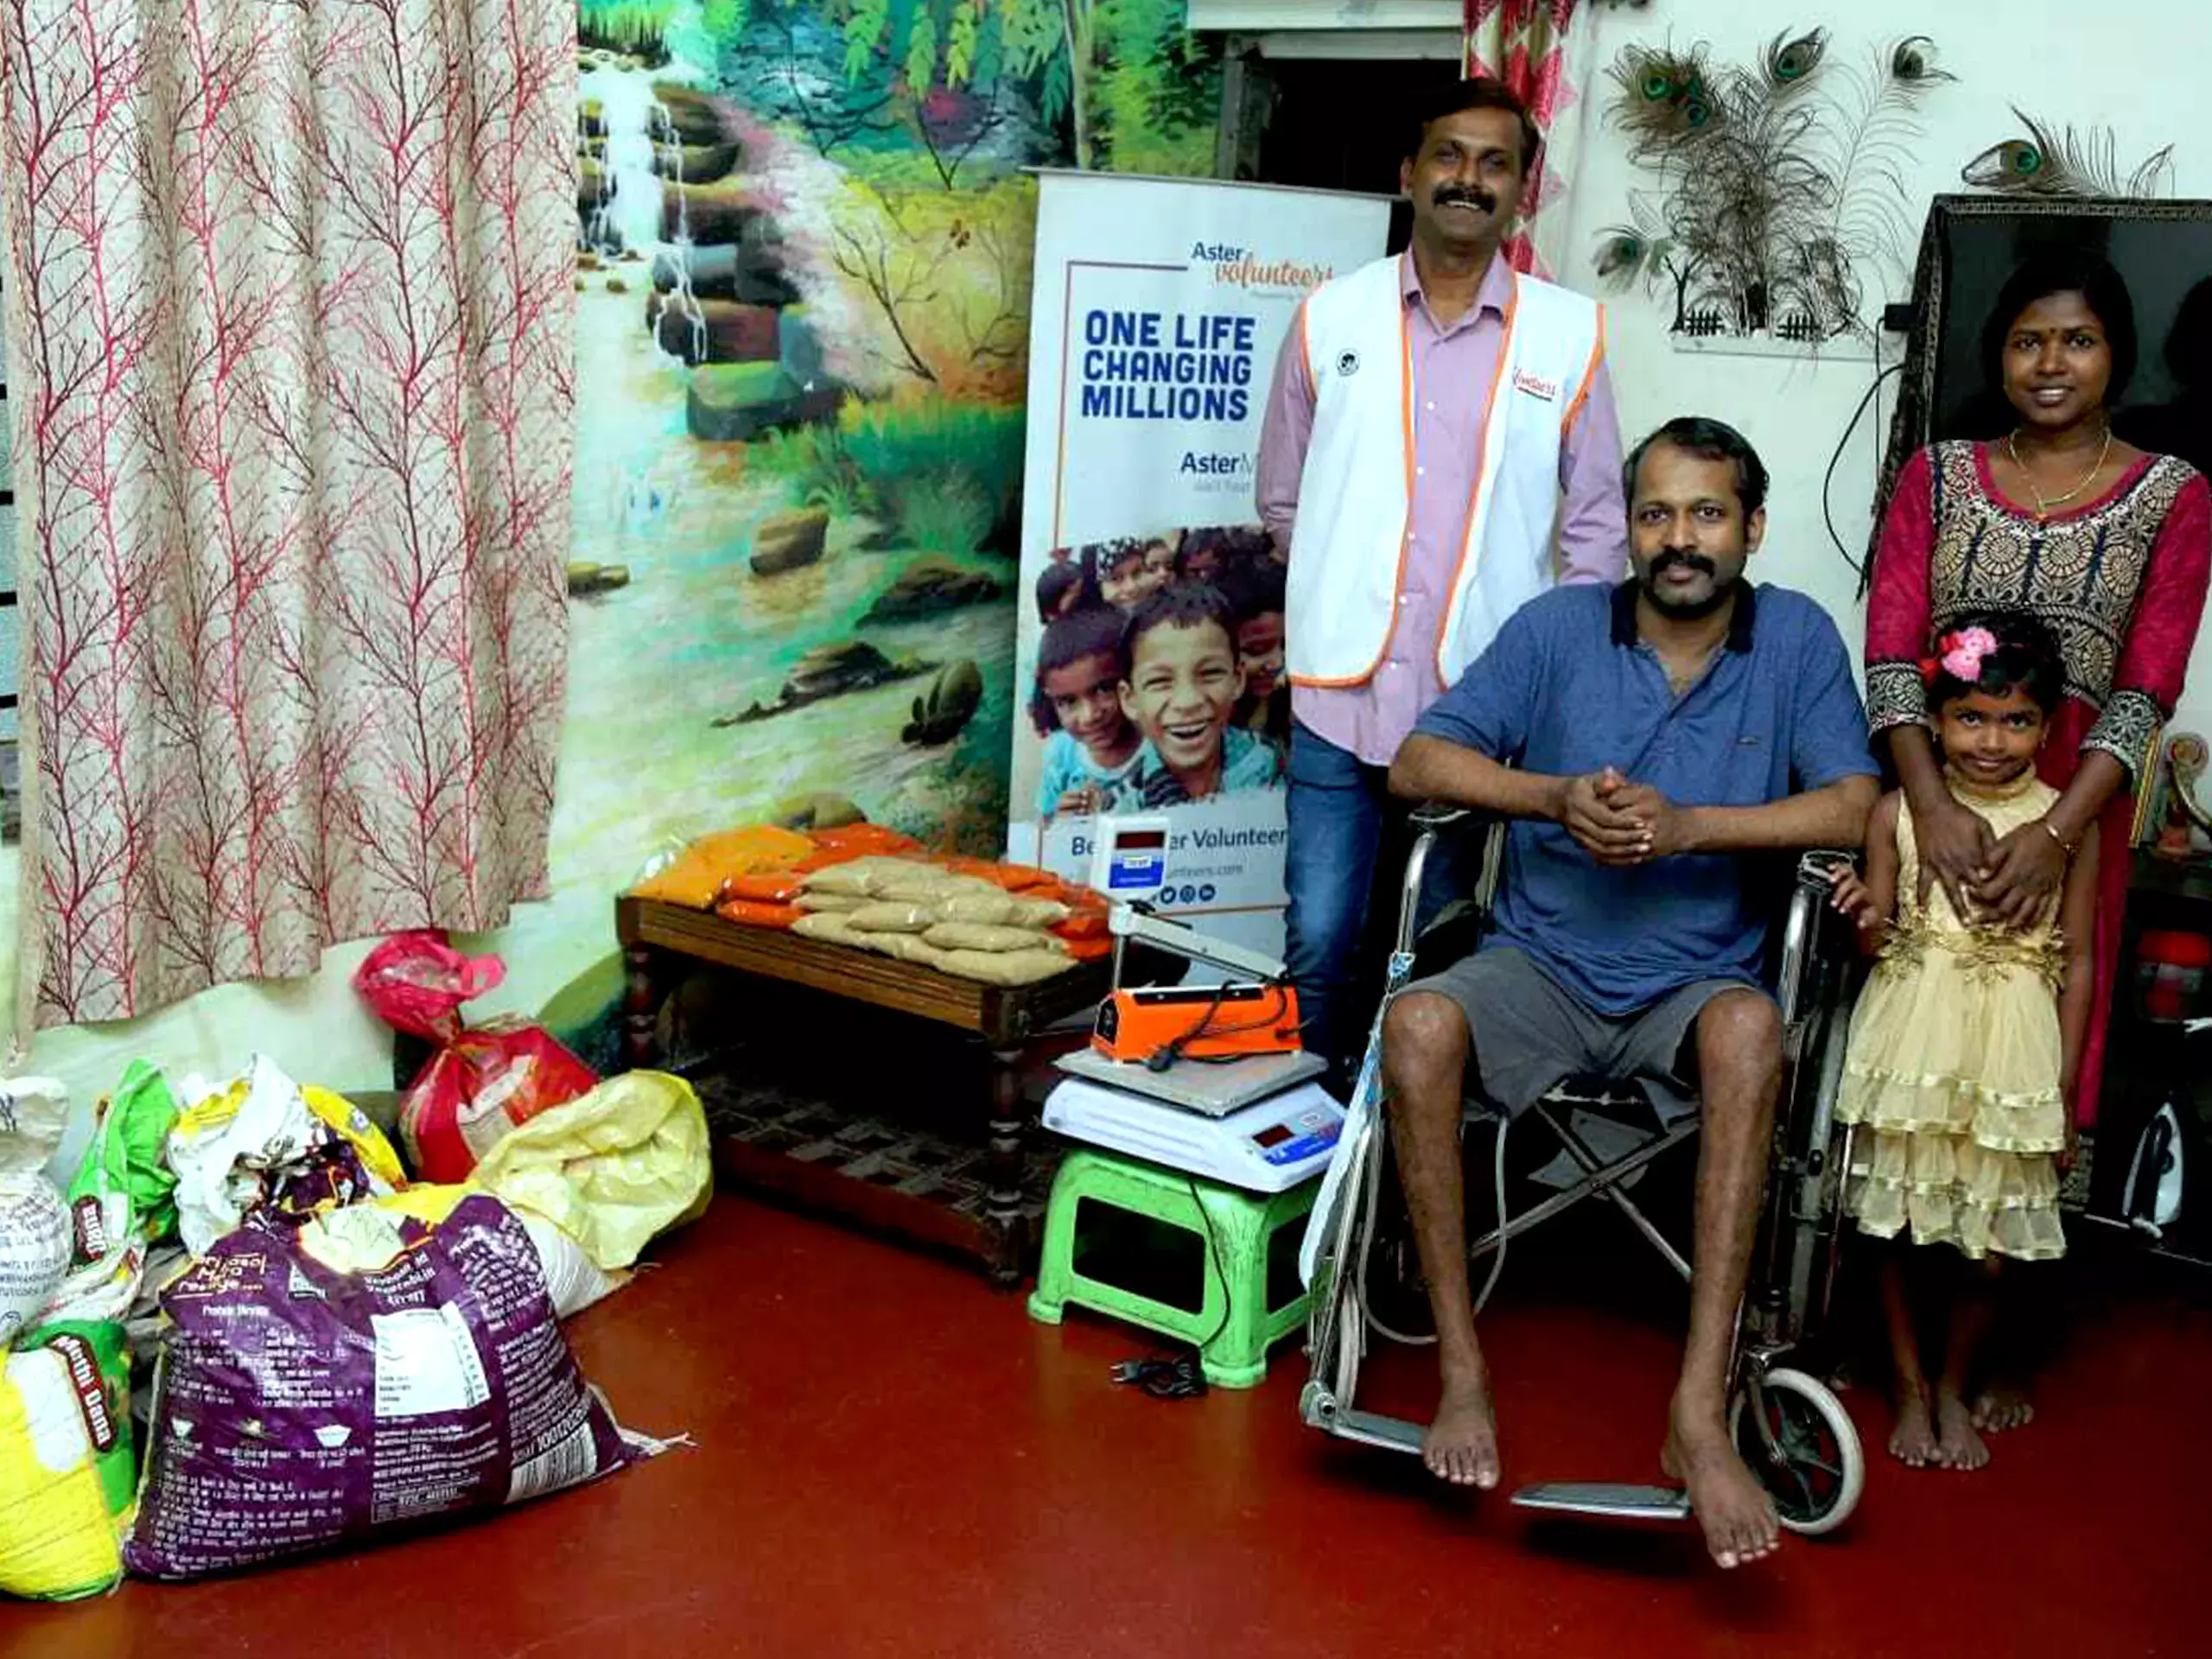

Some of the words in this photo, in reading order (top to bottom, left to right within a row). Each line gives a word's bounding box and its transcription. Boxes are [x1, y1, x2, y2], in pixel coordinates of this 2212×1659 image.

[1191, 241, 1243, 261] Aster
[1085, 310, 1161, 346] ONE
[1175, 314, 1255, 351] LIFE
[1084, 349, 1251, 385] CHANGING
[1082, 385, 1248, 421] MILLIONS
[1192, 827, 1287, 849] Volunteer
